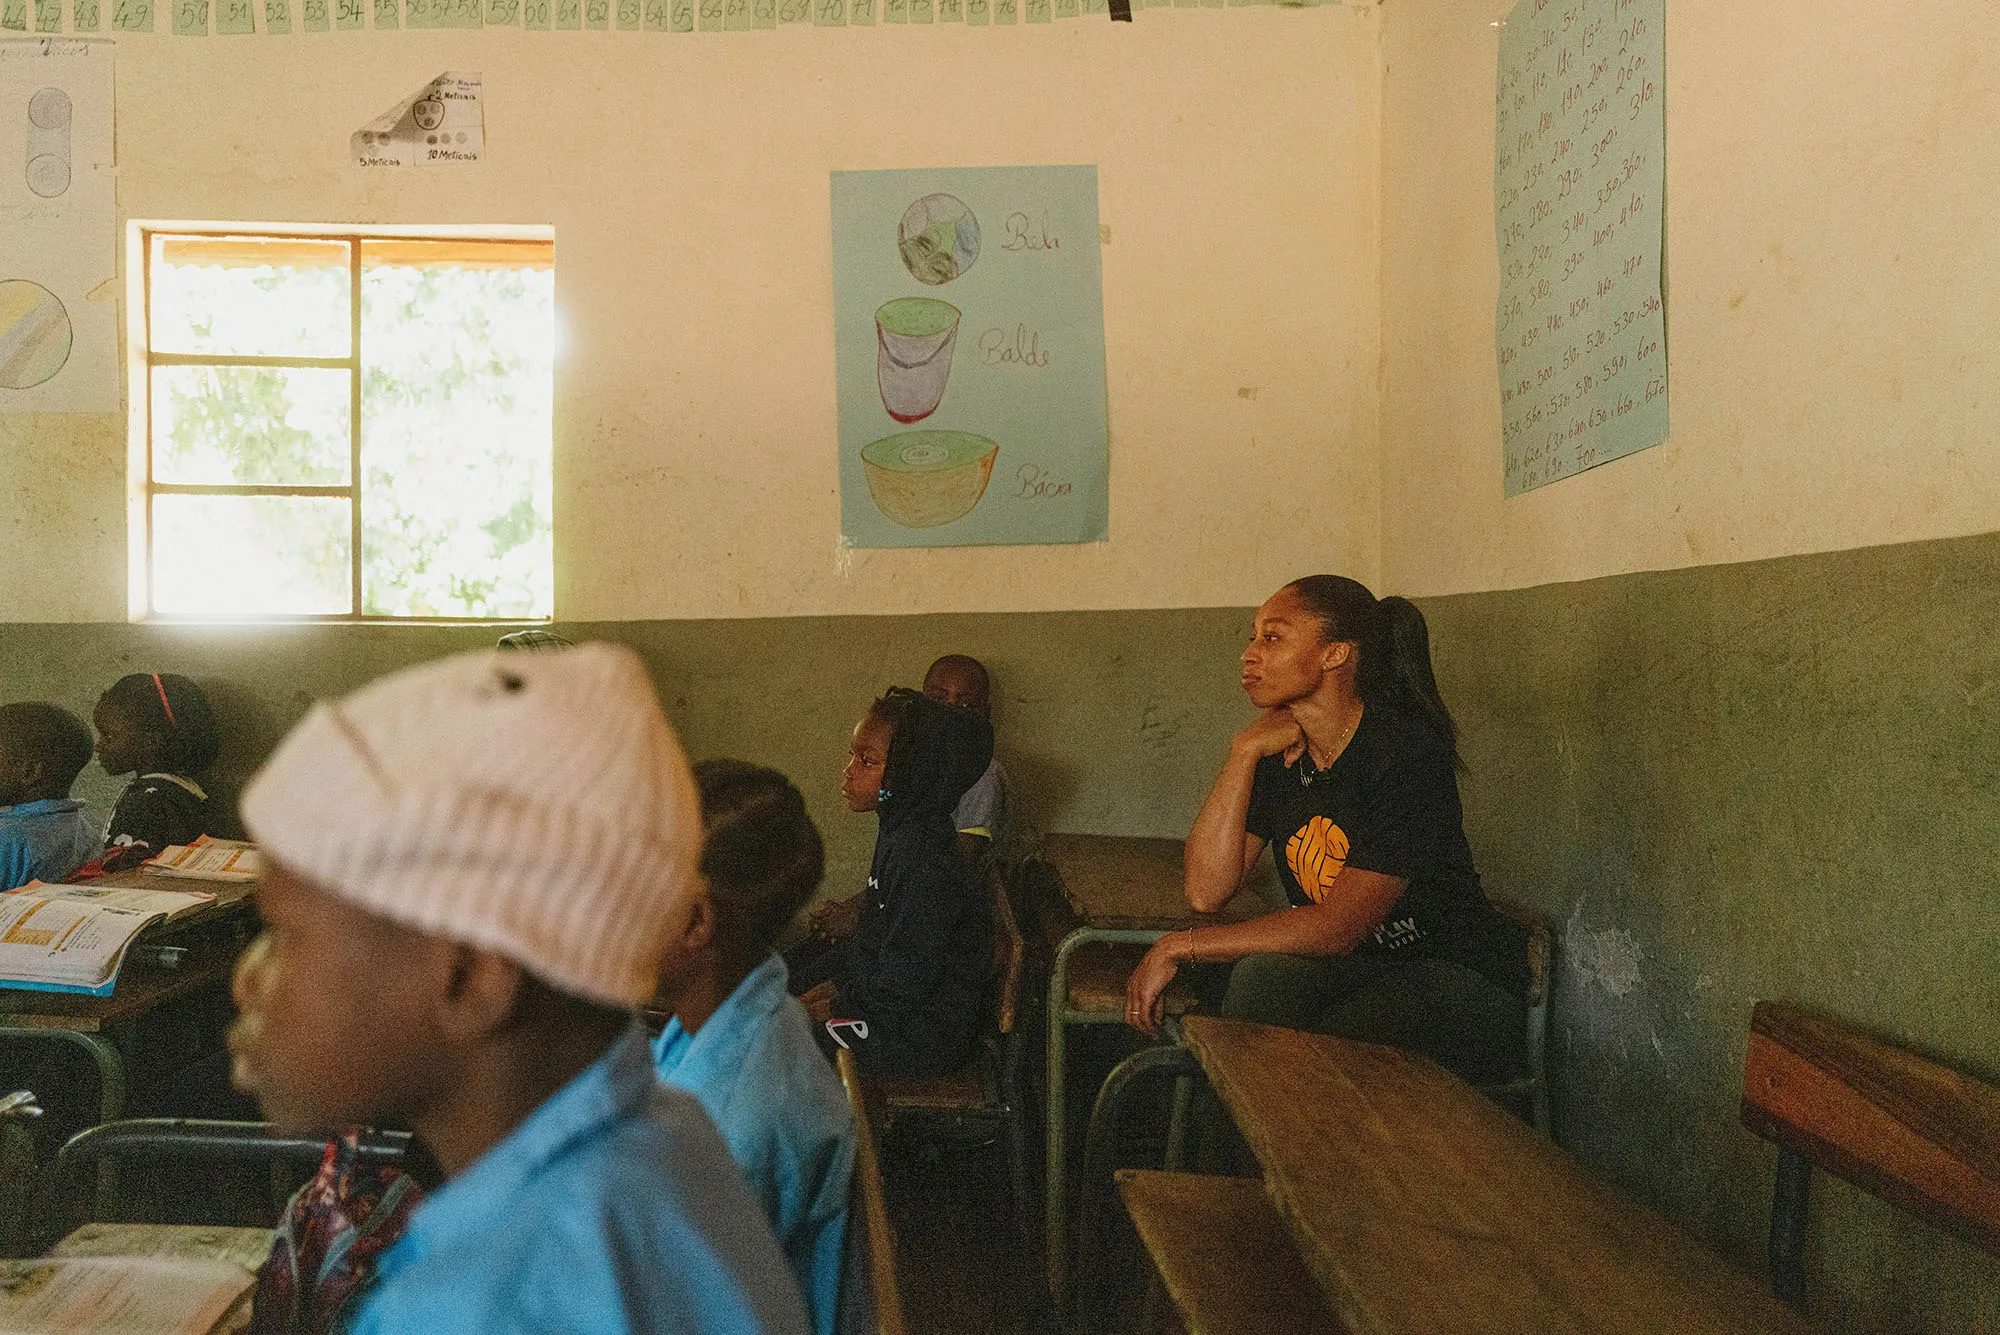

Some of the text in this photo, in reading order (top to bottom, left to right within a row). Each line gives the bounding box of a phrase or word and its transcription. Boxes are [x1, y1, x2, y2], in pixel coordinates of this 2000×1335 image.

[113, 0, 149, 29] 49
[229, 2, 246, 21] 51
[265, 2, 287, 22] 52
[304, 0, 326, 21] 53
[336, 0, 365, 22] 54
[484, 0, 518, 24] 59
[558, 1, 577, 21] 61
[587, 1, 608, 22] 62
[617, 1, 639, 22] 63
[645, 0, 667, 26] 64
[672, 0, 692, 25] 65
[699, 0, 721, 19] 66
[360, 158, 368, 167] 5
[428, 149, 478, 161] 10 Meticais
[980, 323, 1049, 367] Balde
